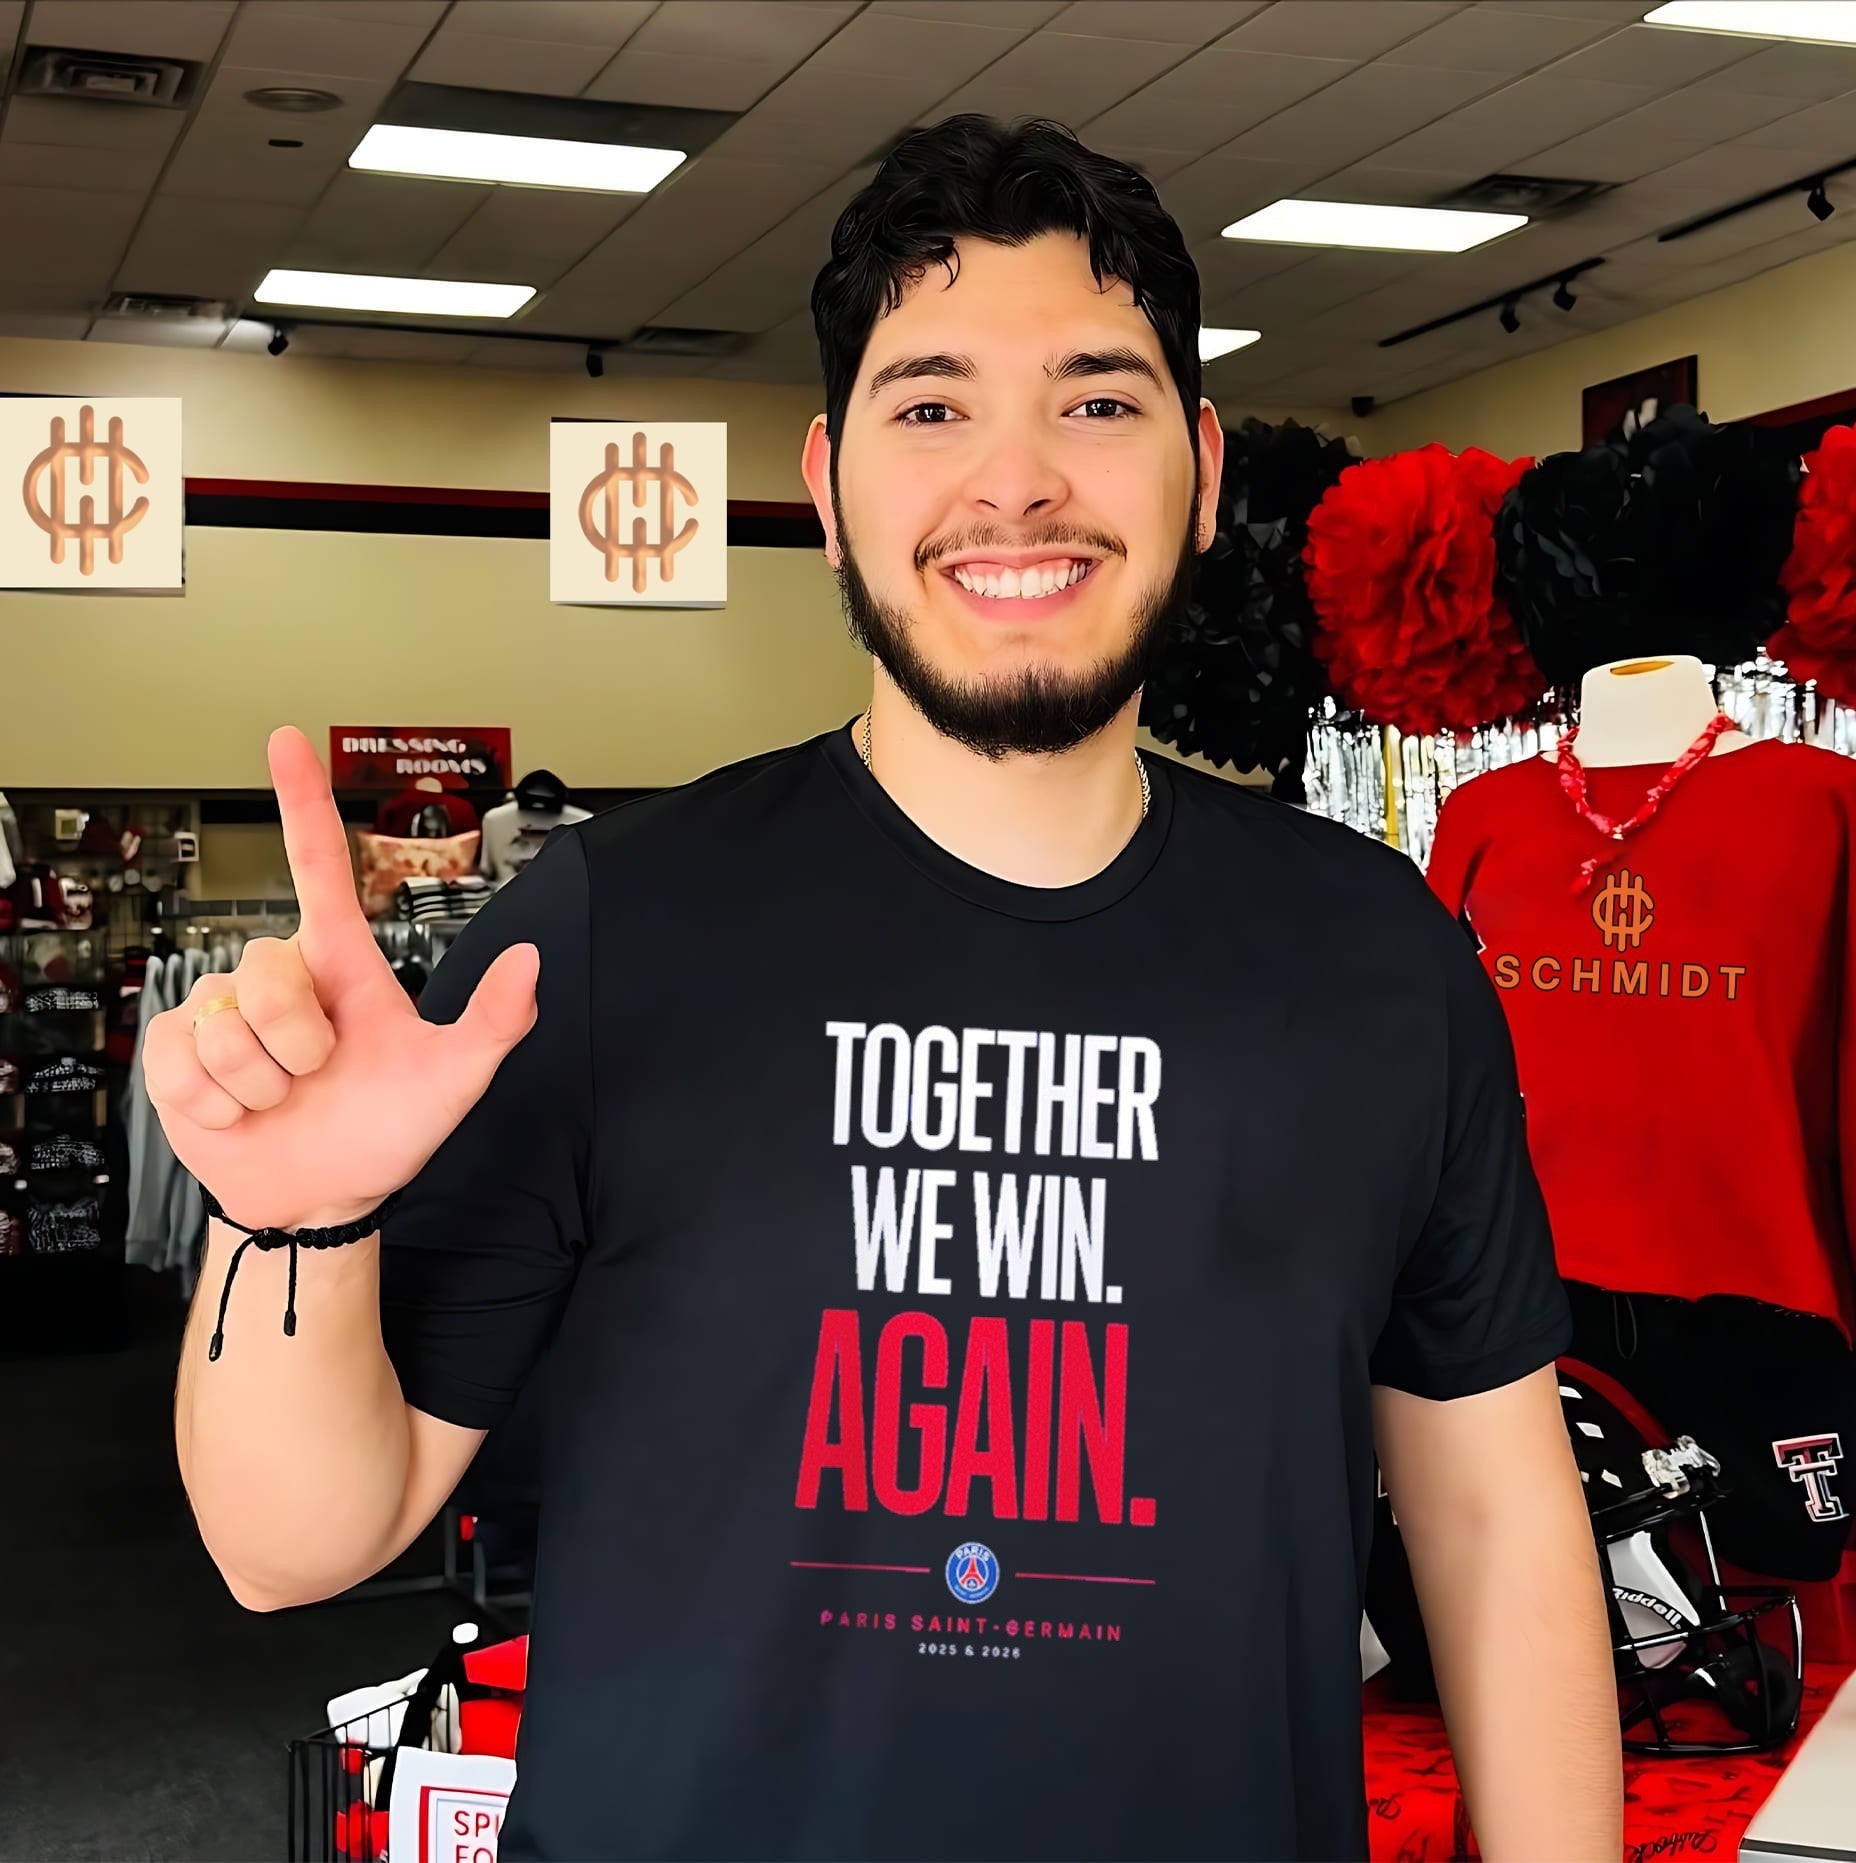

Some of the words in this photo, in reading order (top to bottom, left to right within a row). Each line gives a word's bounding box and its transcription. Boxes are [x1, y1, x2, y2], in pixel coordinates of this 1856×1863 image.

[342, 737, 467, 754] DRESSING
[396, 758, 487, 775] ROOMS
[1494, 953, 1746, 1001] SCHMIDT
[825, 1020, 1162, 1162] TOGETHER
[850, 1164, 957, 1296] WE
[972, 1170, 1123, 1304] WIN.
[794, 1308, 1157, 1527] AGAIN.
[820, 1609, 896, 1631] PARIS
[911, 1614, 1121, 1642] SAINT-GERMAIN
[918, 1642, 957, 1656] 2025
[964, 1644, 975, 1656] &
[982, 1645, 1021, 1659] 2026
